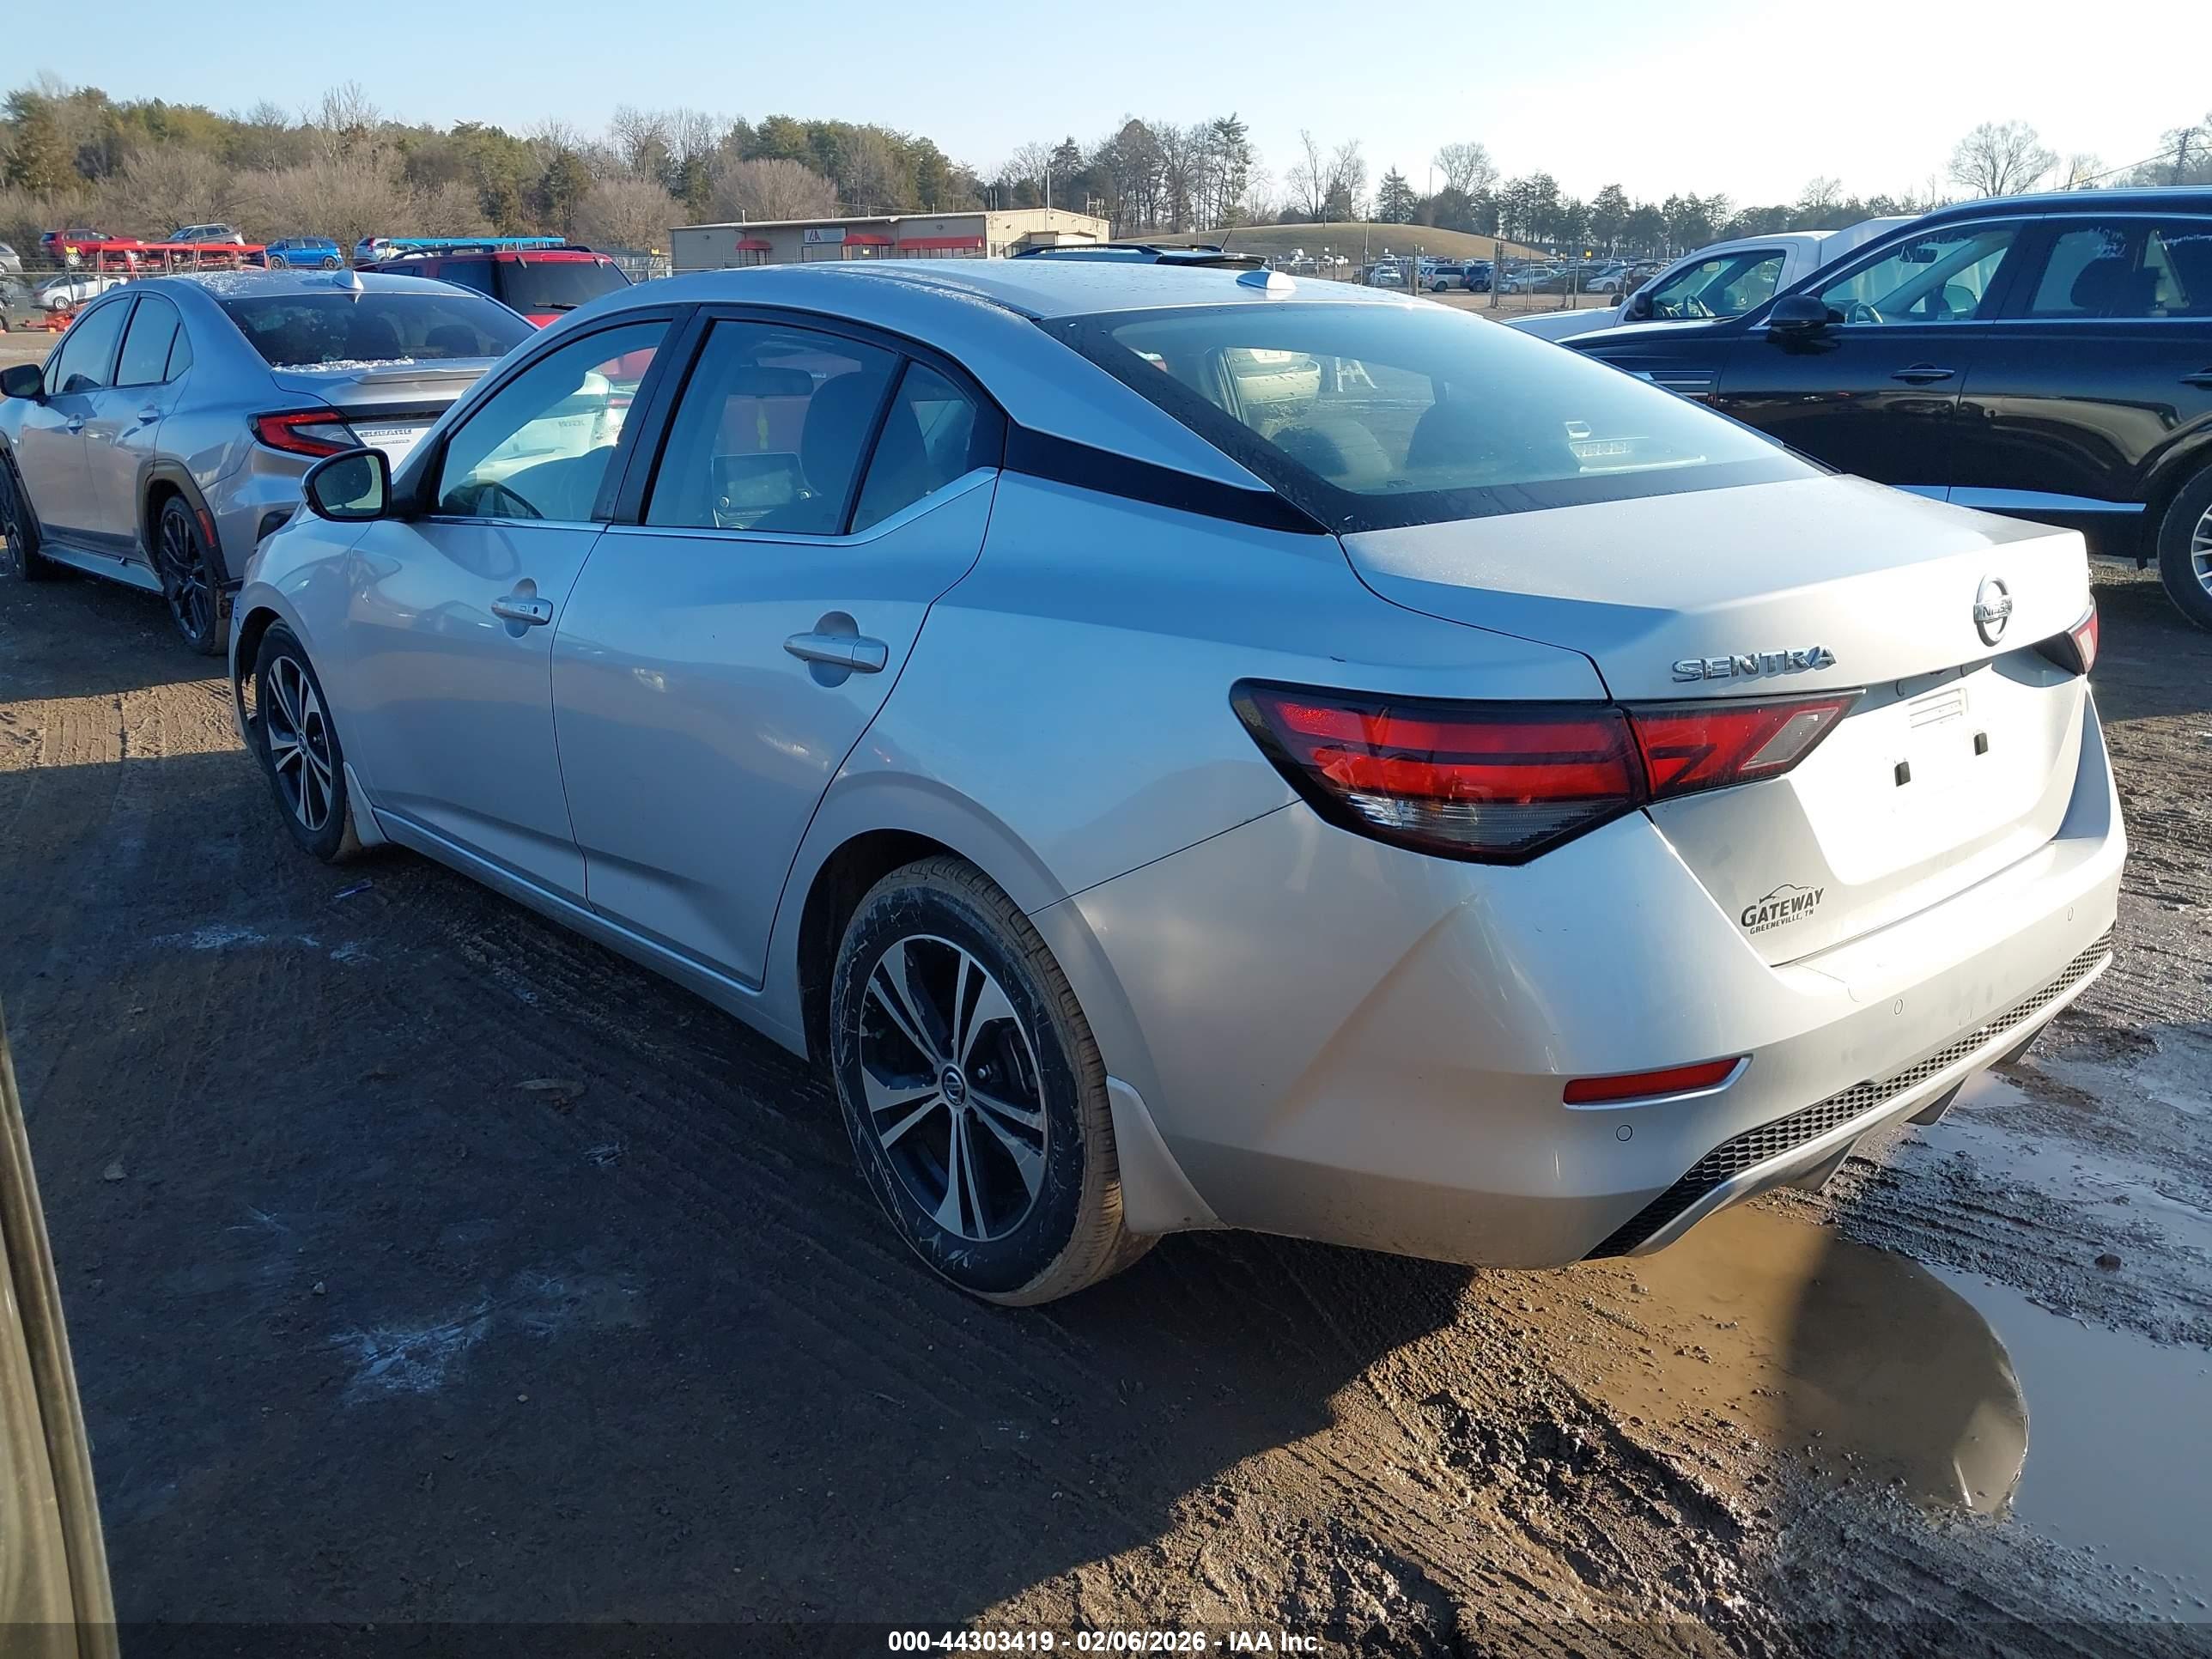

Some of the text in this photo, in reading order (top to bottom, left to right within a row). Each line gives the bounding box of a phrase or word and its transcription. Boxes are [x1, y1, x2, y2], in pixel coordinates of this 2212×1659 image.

[1672, 646, 1837, 683] SENTRA
[1741, 887, 1824, 927] GATEWAY
[1805, 908, 1814, 917] TN
